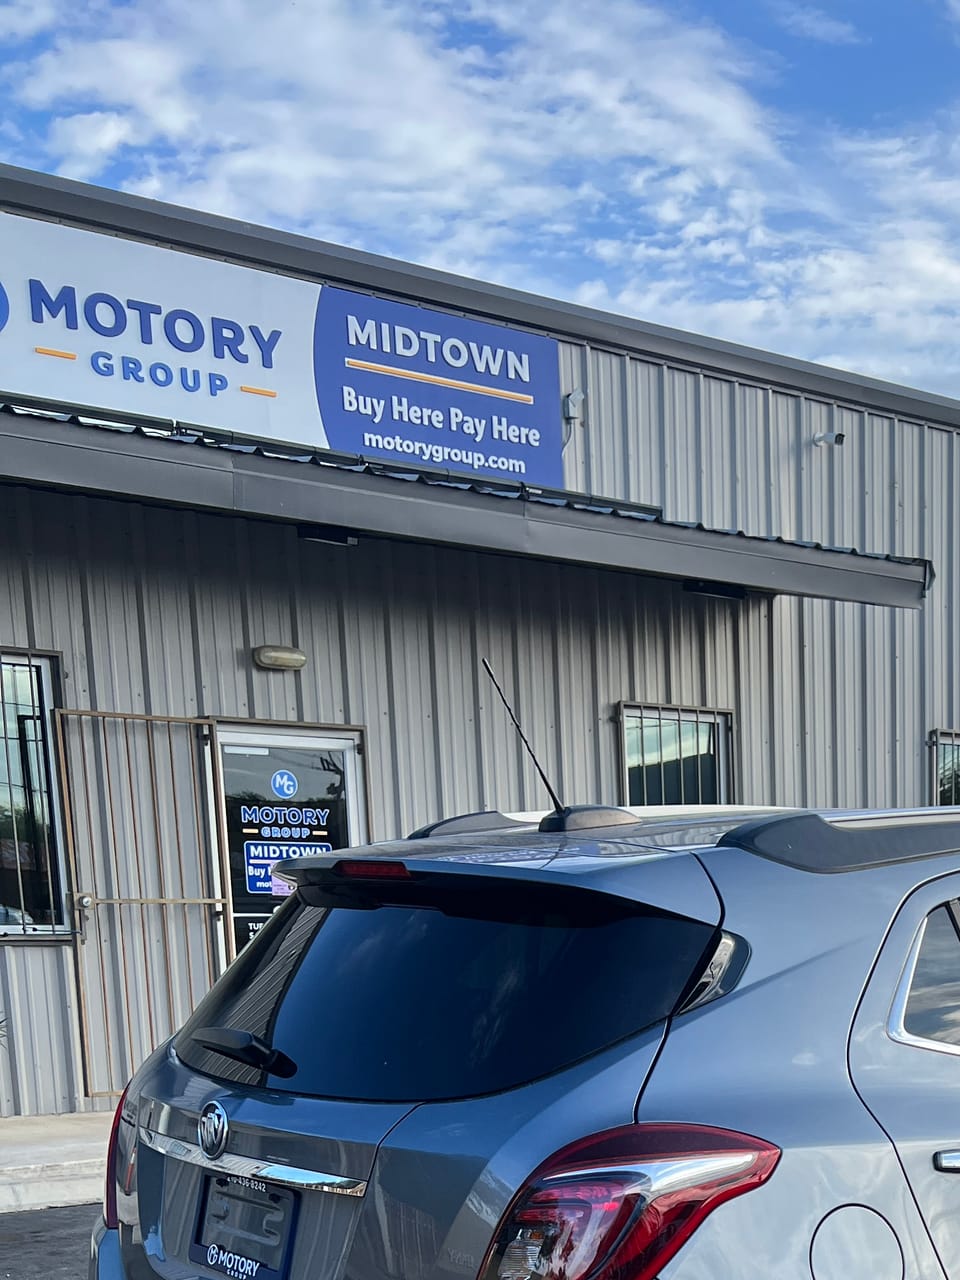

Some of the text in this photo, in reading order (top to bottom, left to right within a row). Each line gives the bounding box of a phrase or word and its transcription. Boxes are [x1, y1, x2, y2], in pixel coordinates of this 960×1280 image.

[29, 279, 282, 369] MOTORY
[347, 314, 531, 382] MIDTOWN
[90, 351, 229, 397] GROUP
[342, 385, 541, 447] Buy Here Pay Here
[363, 432, 526, 474] motorygroup.com
[275, 774, 294, 795] MG
[241, 805, 330, 826] MOTORY
[261, 826, 311, 839] GROUP
[248, 866, 266, 878] Buy
[218, 1250, 260, 1277] MOTORY
